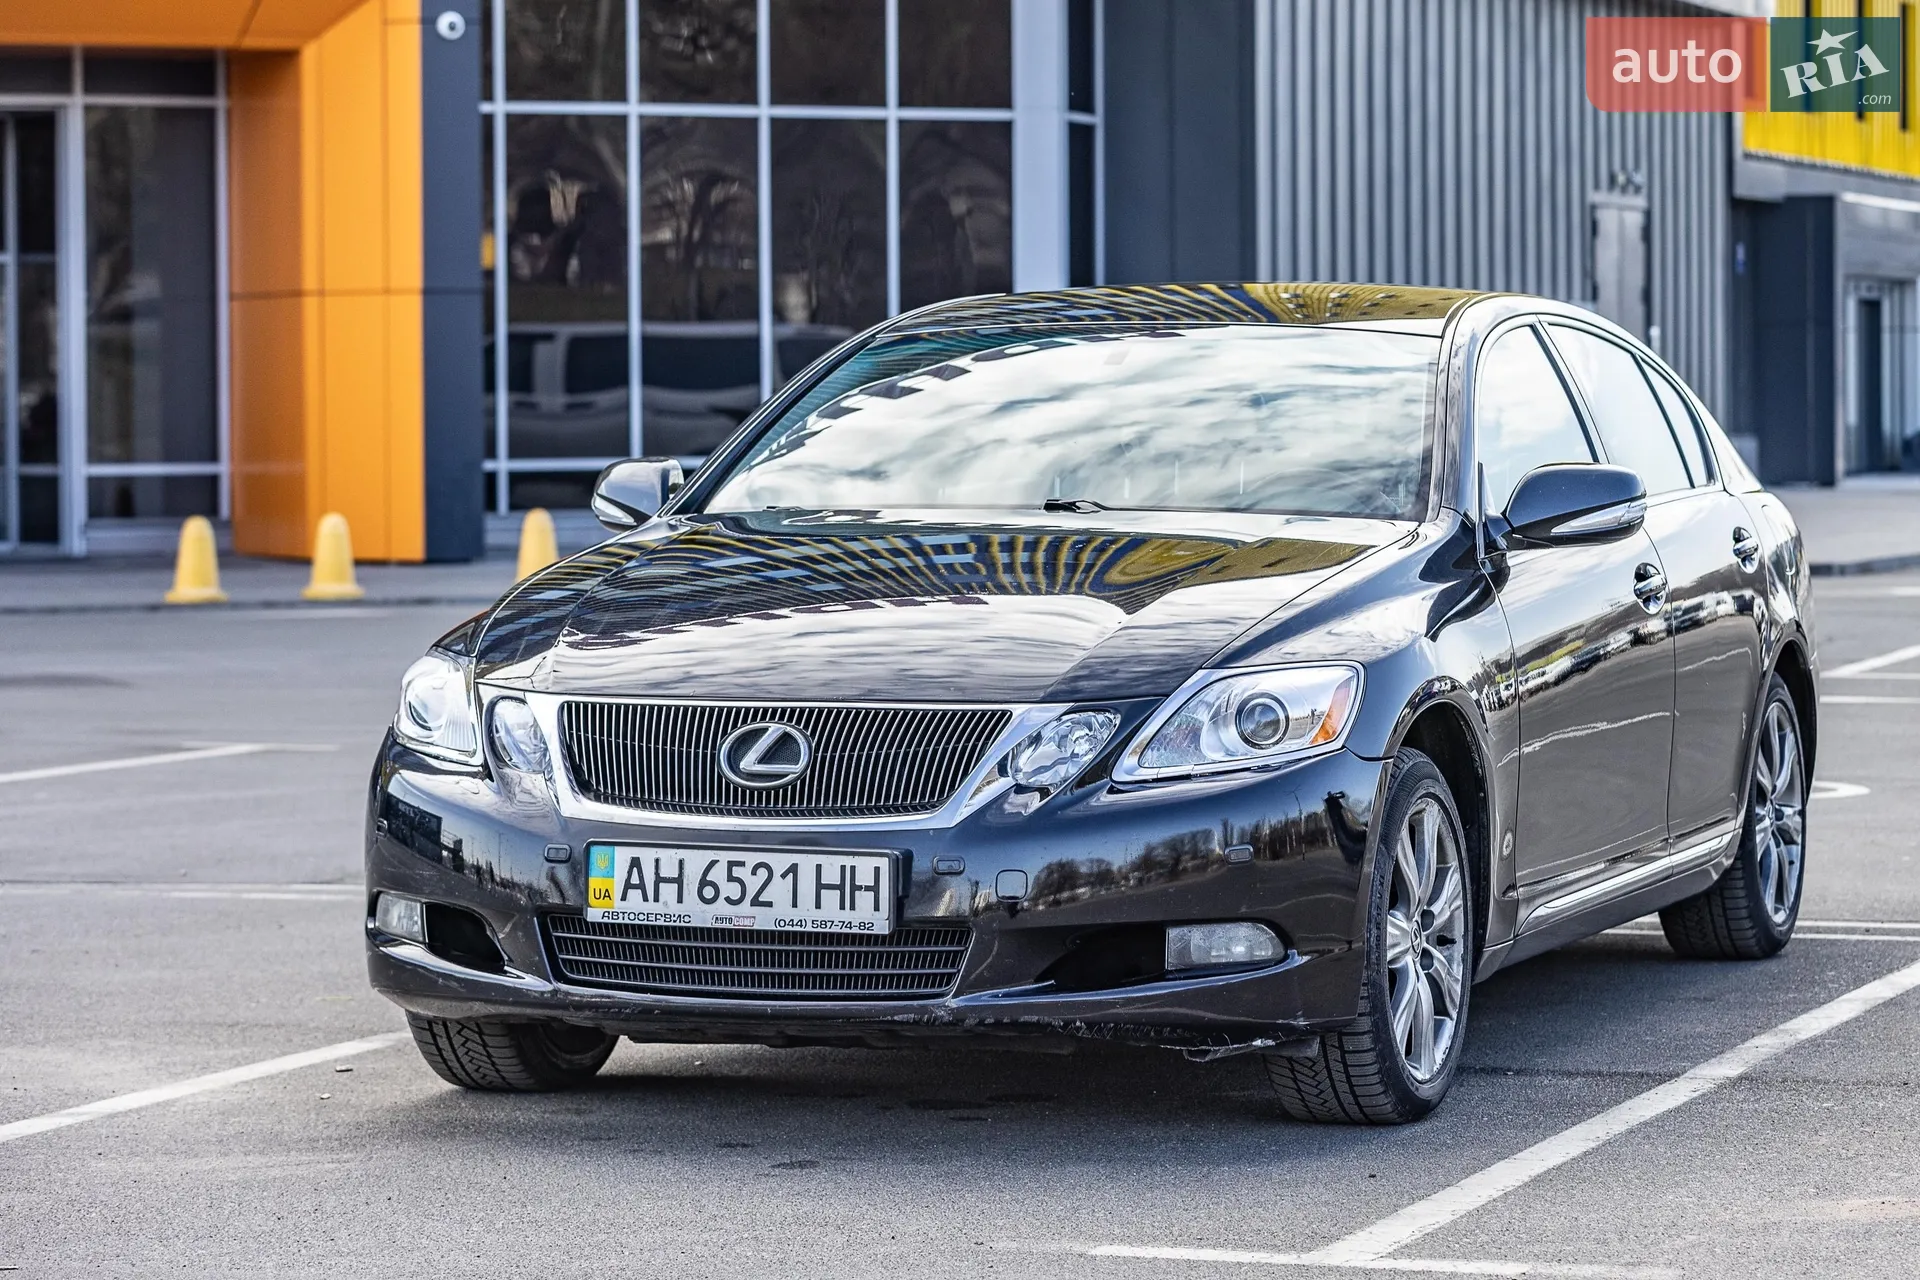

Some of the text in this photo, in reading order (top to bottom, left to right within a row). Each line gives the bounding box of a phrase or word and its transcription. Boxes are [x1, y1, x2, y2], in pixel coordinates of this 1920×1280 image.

[620, 856, 881, 912] AH 6521 HH
[593, 887, 612, 901] UA
[601, 910, 692, 924] АВТОСЕРВИС
[774, 918, 874, 931] (044) 587-74-82
